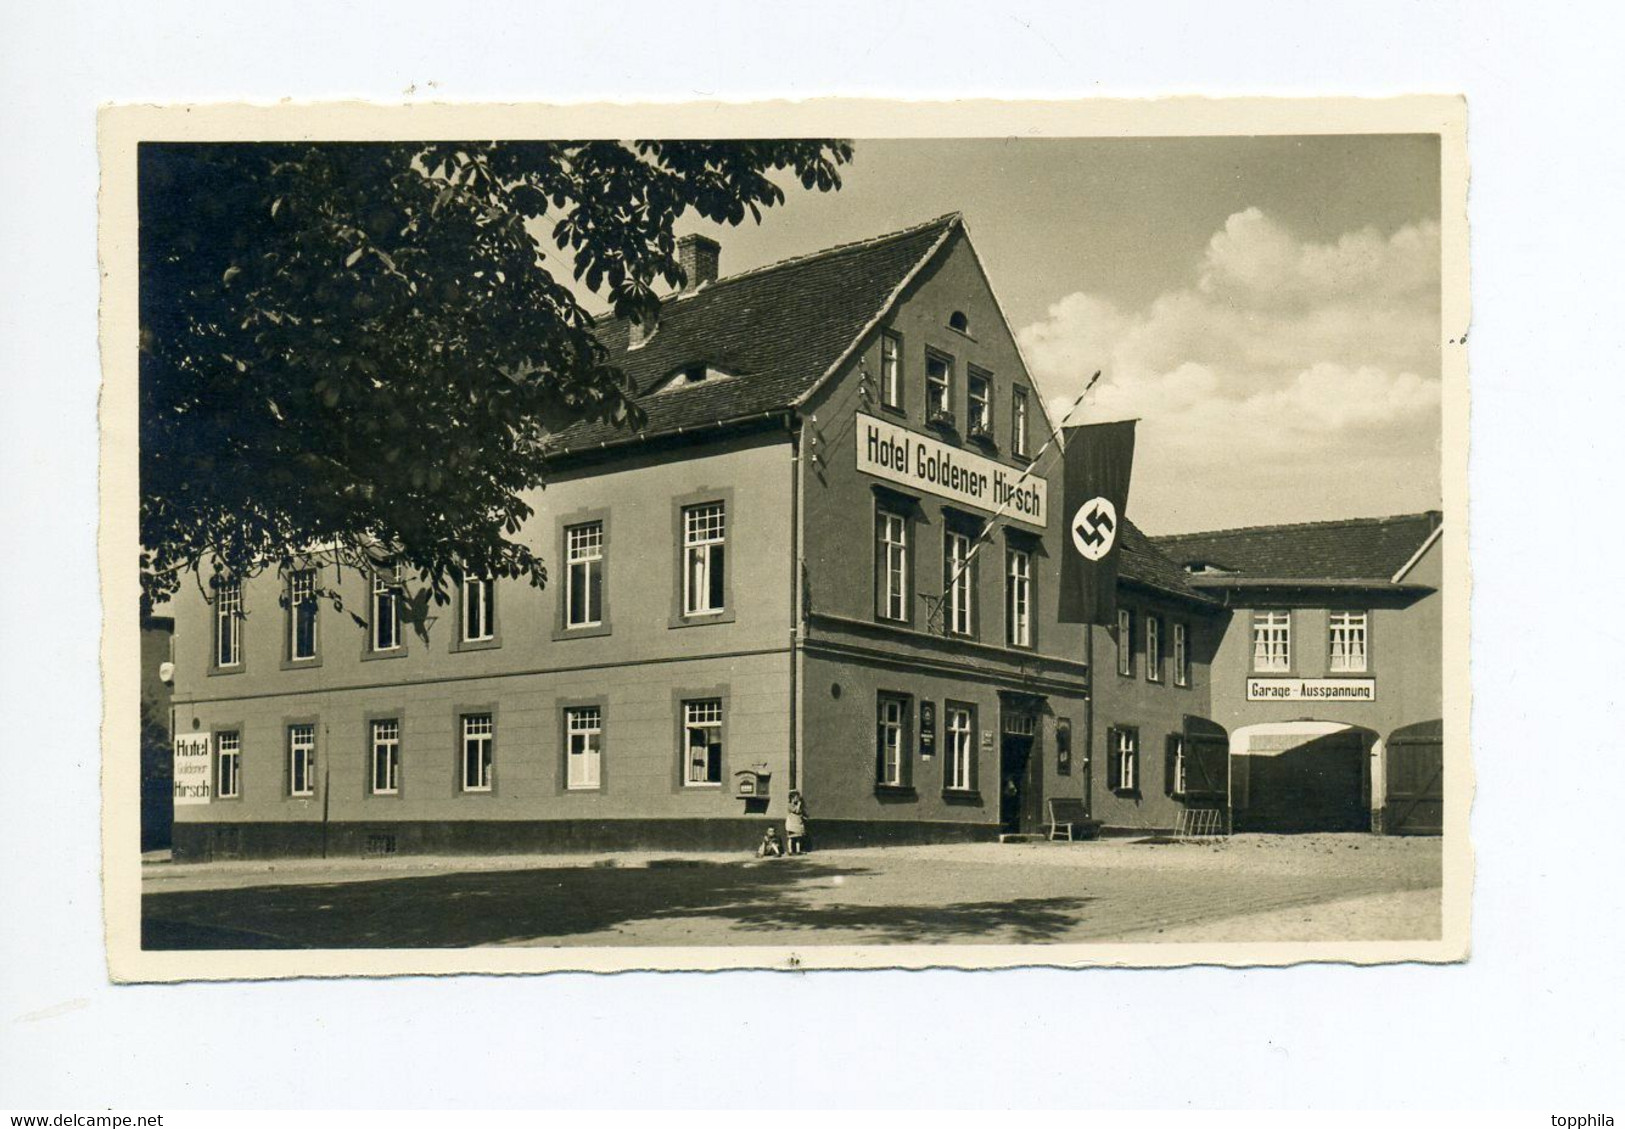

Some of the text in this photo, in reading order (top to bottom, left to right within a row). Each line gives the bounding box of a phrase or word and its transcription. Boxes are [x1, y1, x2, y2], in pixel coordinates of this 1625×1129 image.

[867, 424, 1040, 517] Hotel Goldener Hirsch
[1251, 682, 1291, 698] Garage
[1300, 682, 1371, 698] Ausspannung
[176, 738, 208, 757] Hotel
[174, 780, 210, 798] Hirsch
